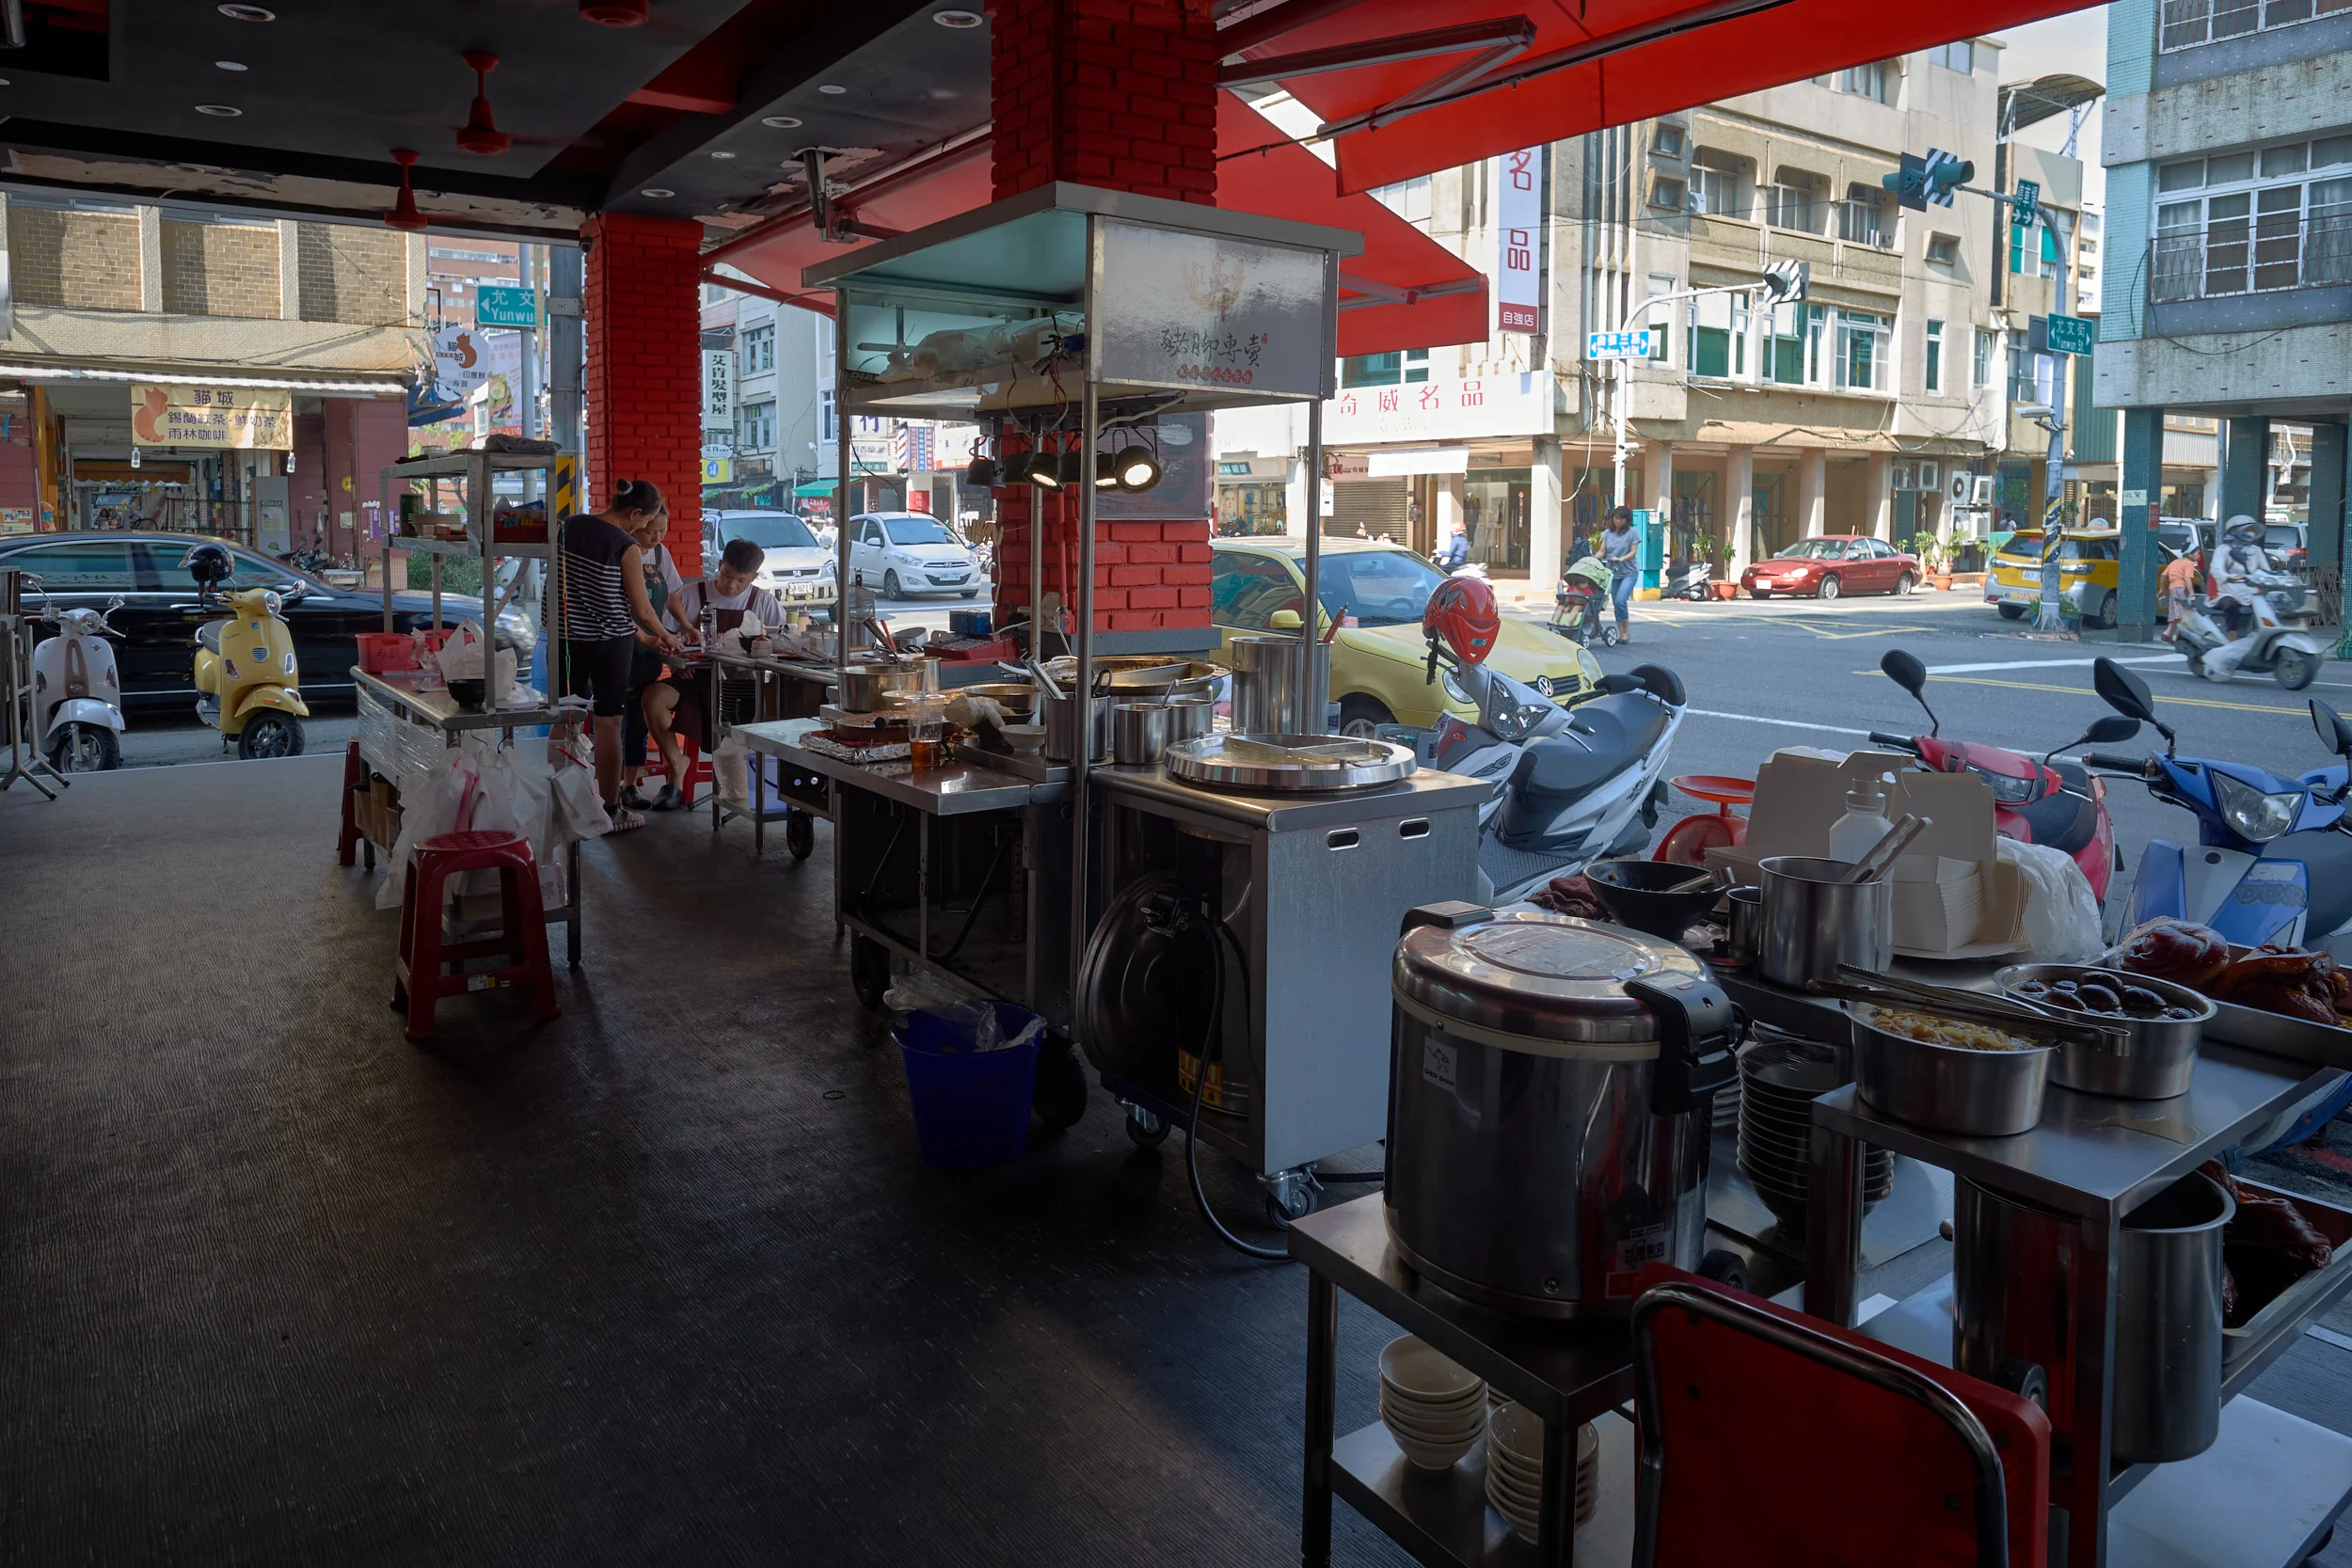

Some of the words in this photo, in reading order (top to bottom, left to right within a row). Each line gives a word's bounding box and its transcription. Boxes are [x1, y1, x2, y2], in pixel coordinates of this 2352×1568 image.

[492, 289, 535, 307] 允文
[491, 308, 535, 323] Yunwu
[1502, 311, 1534, 327] 自強店
[194, 388, 234, 405] 貓城
[1340, 380, 1484, 416] 奇威名品
[168, 428, 226, 441] 雨林咖啡
